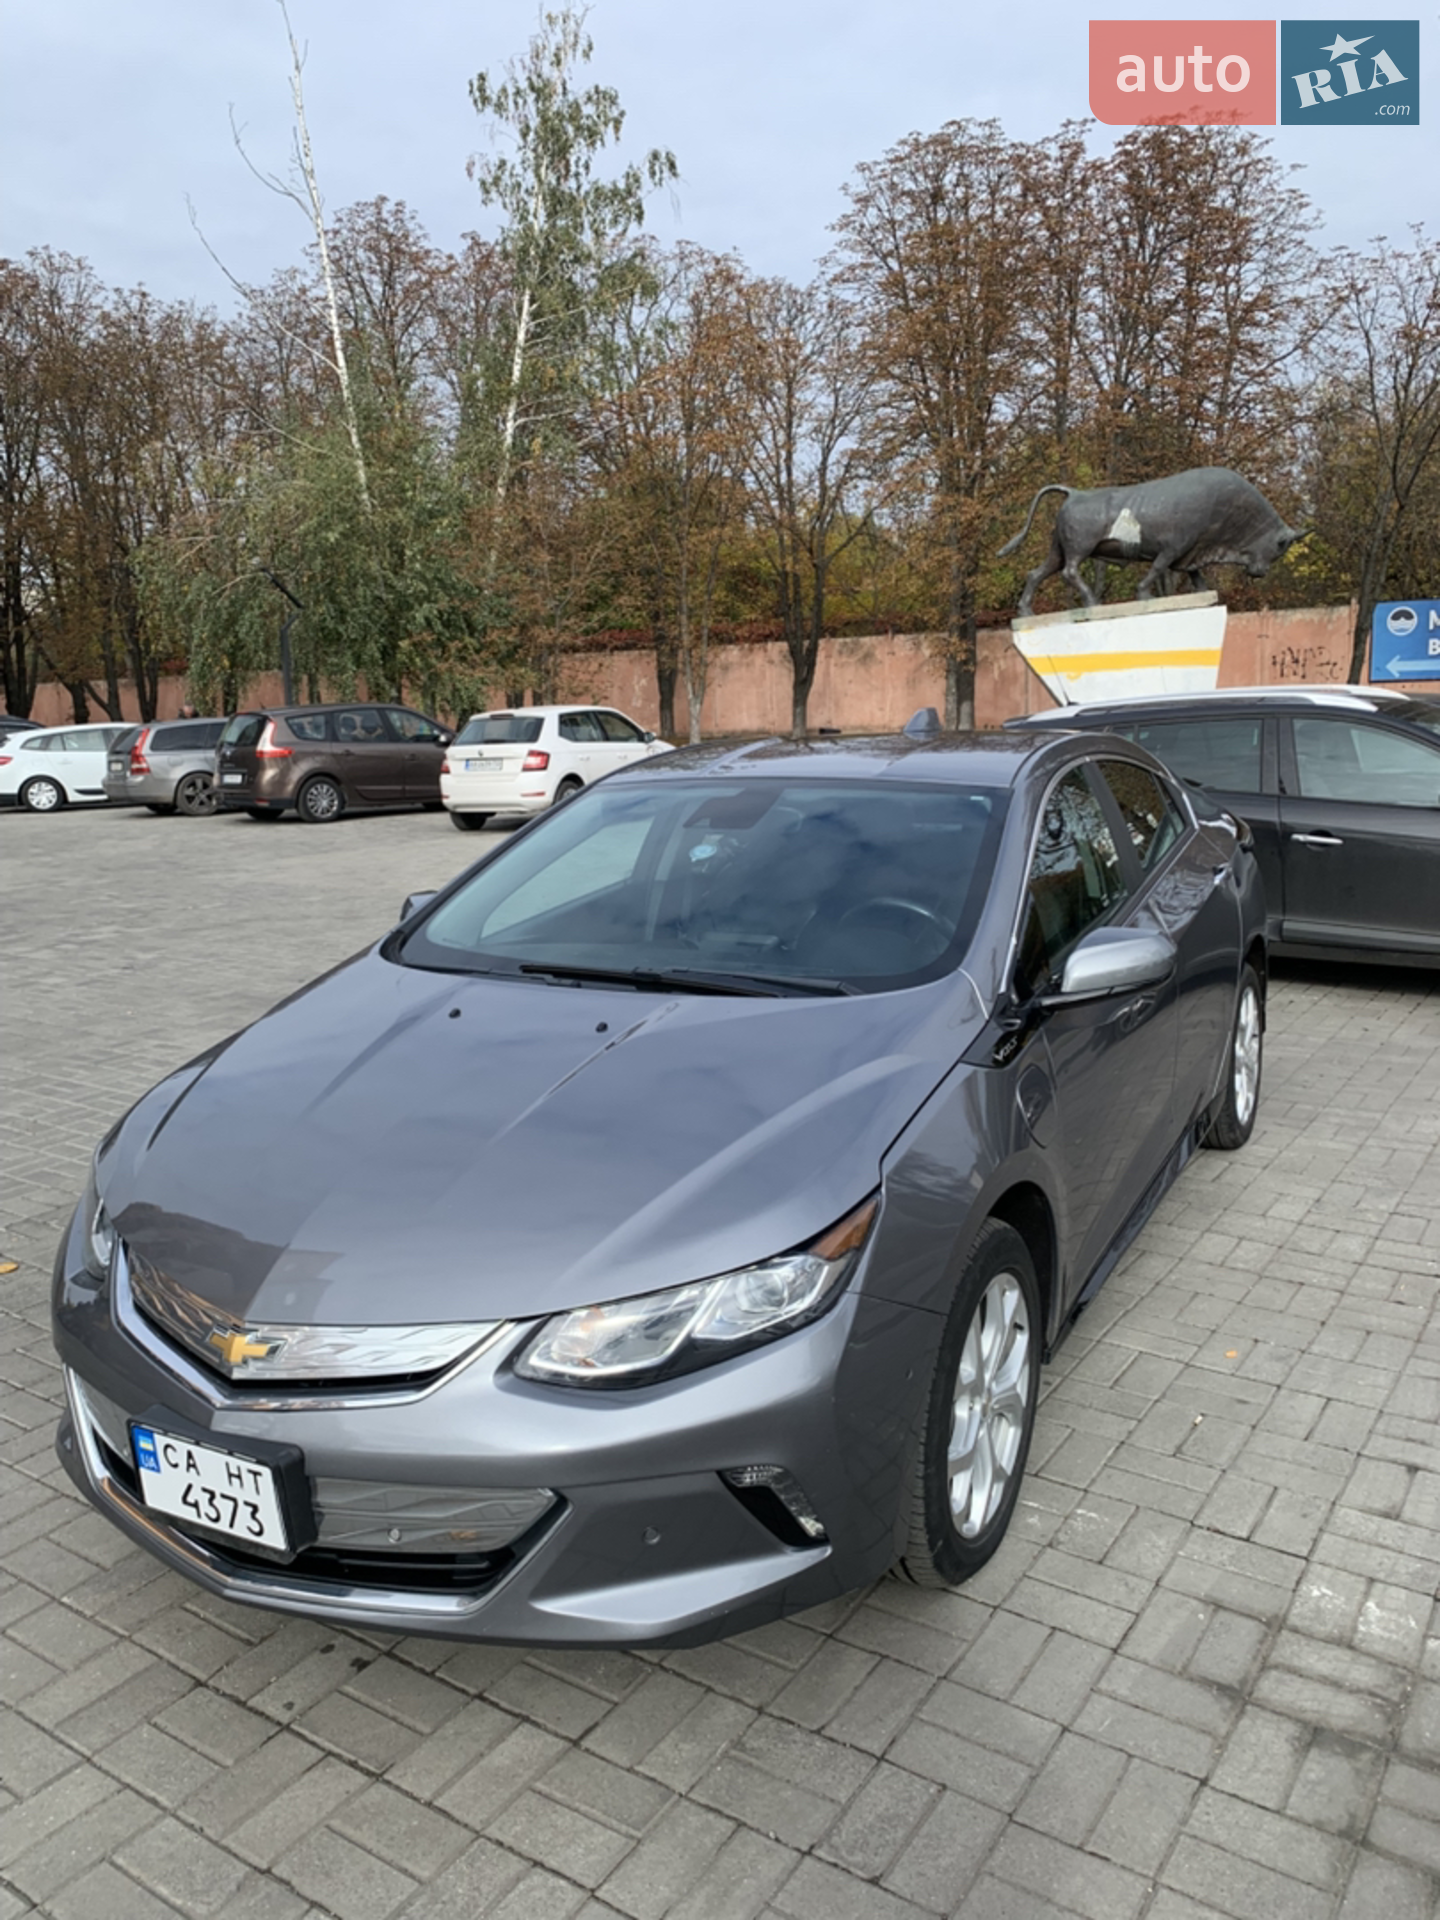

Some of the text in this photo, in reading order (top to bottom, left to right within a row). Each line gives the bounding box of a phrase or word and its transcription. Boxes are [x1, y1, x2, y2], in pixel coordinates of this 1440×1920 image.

[140, 1452, 158, 1470] UA
[163, 1443, 263, 1496] CA HT
[181, 1483, 265, 1537] 4373
